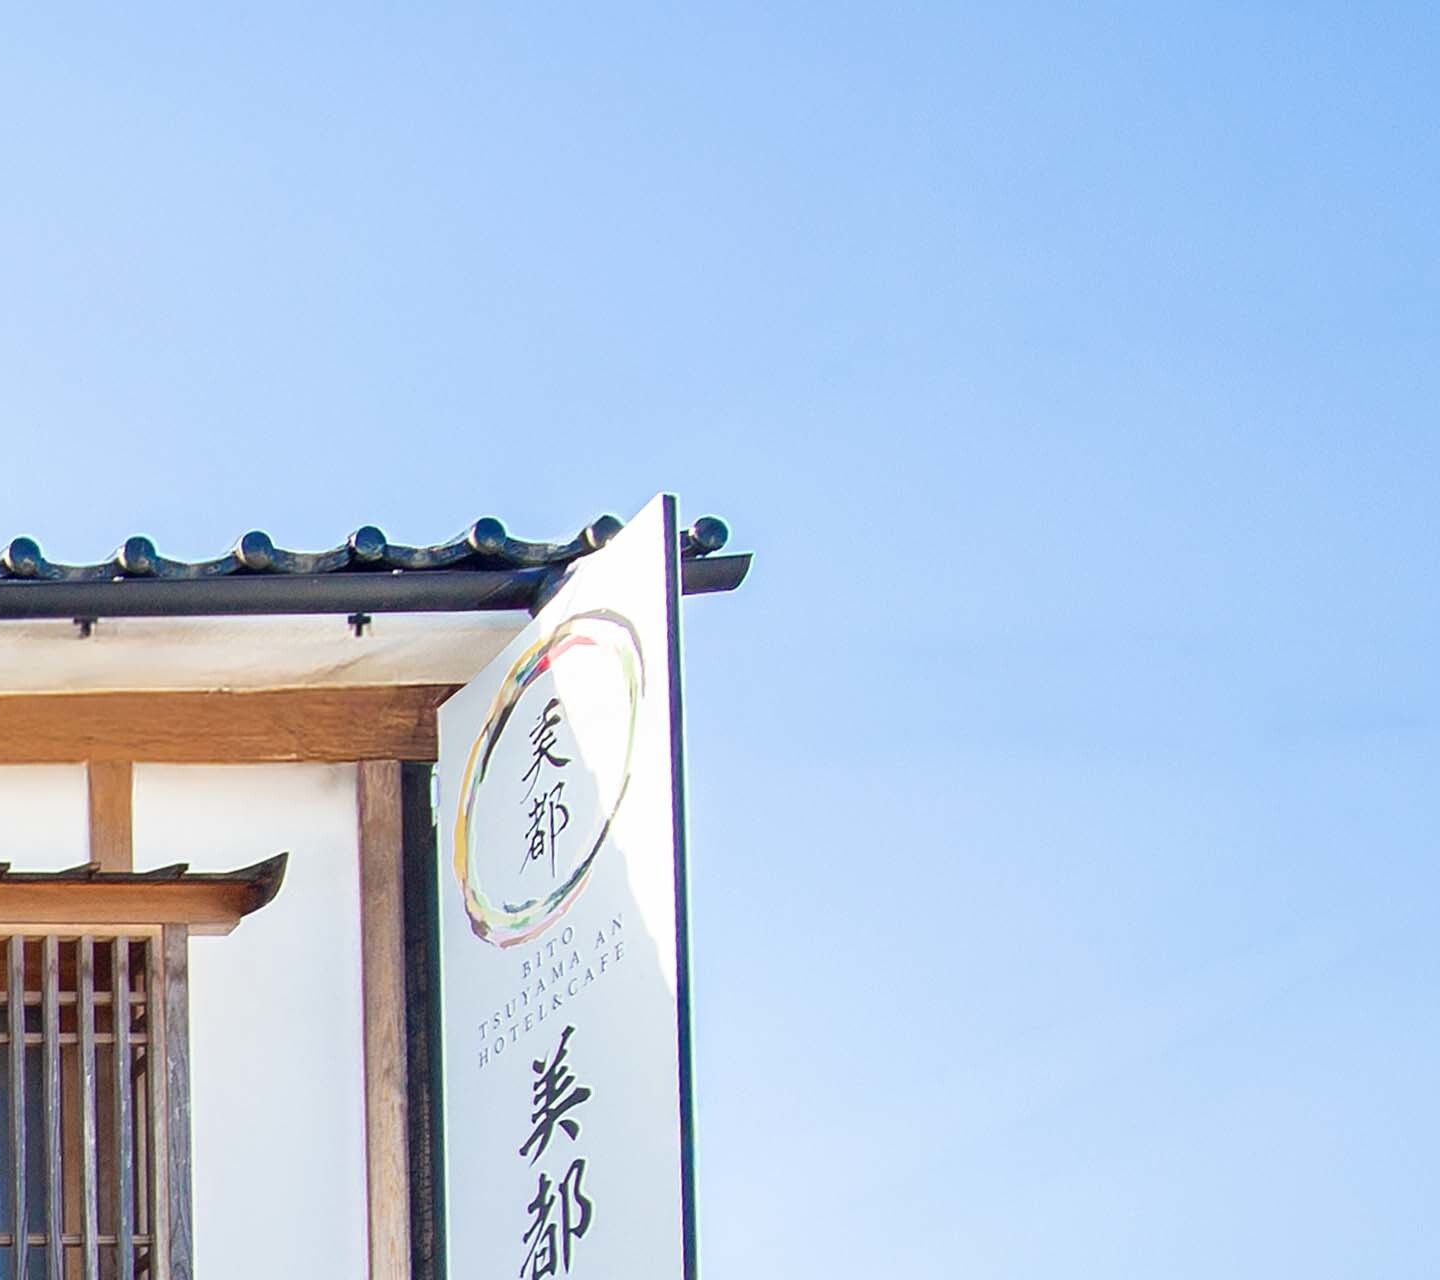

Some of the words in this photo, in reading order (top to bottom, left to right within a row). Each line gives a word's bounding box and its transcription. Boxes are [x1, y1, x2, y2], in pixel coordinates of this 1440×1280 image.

[520, 697, 572, 878] 美都
[478, 950, 580, 1040] TSUYAMA
[594, 912, 624, 950] AN
[478, 941, 624, 1068] HOTEL&CAFE
[522, 926, 574, 979] BITO
